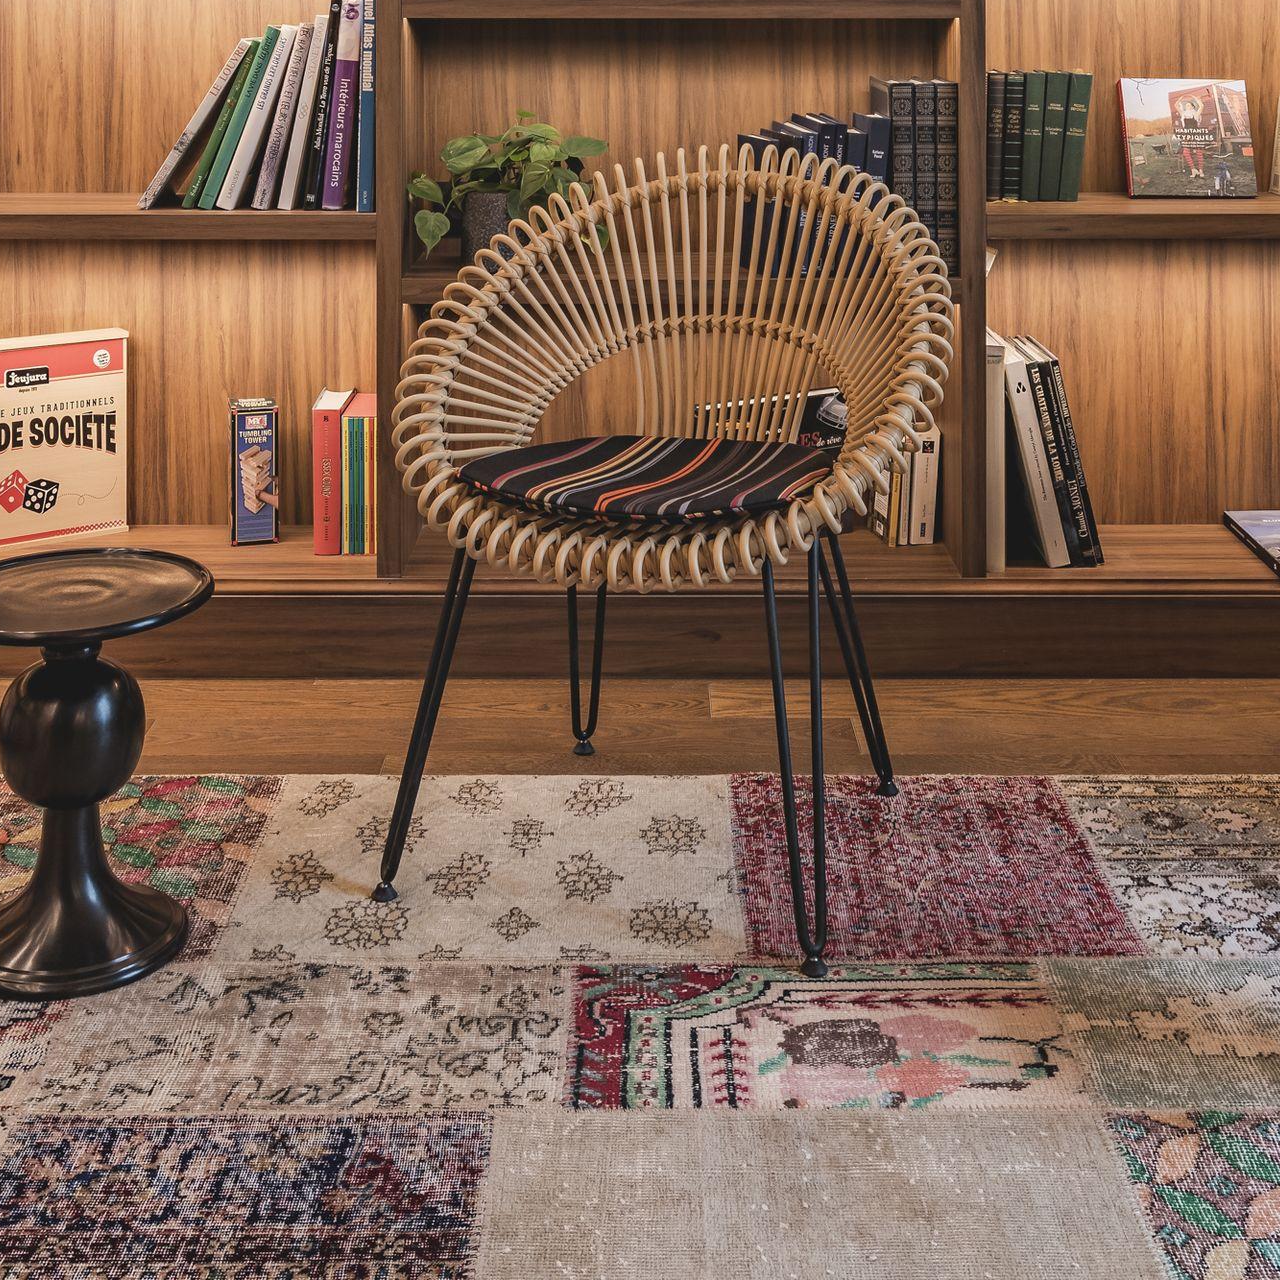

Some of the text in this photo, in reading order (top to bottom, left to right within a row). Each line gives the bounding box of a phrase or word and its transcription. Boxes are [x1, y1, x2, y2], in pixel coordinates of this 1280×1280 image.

[257, 36, 272, 54] forêt
[363, 23, 375, 49] Atlas
[324, 43, 334, 65] l'Espace
[209, 45, 247, 96] LE LOUVRE
[250, 62, 262, 79] DANS
[256, 37, 287, 110] LES GRANDS EXPLORATEURS
[324, 66, 330, 74] de
[362, 50, 374, 92] mondial
[245, 90, 253, 98] LA
[247, 80, 256, 89] VIE
[320, 86, 328, 100] Terre
[316, 113, 324, 136] Mondial
[330, 78, 351, 188] Intérieurs marocains
[226, 169, 241, 199] LAROUSSE
[11, 406, 35, 416] JEUX
[41, 396, 115, 413] TRADITIONNELS
[29, 410, 117, 454] SOCIÉTÉ
[239, 430, 272, 438] TUMBLING
[1031, 367, 1064, 481] LES CHATEAUX DE LA LOIRE
[320, 458, 332, 498] ESSEX COUNTY
[1067, 480, 1088, 538] Claude MONET
